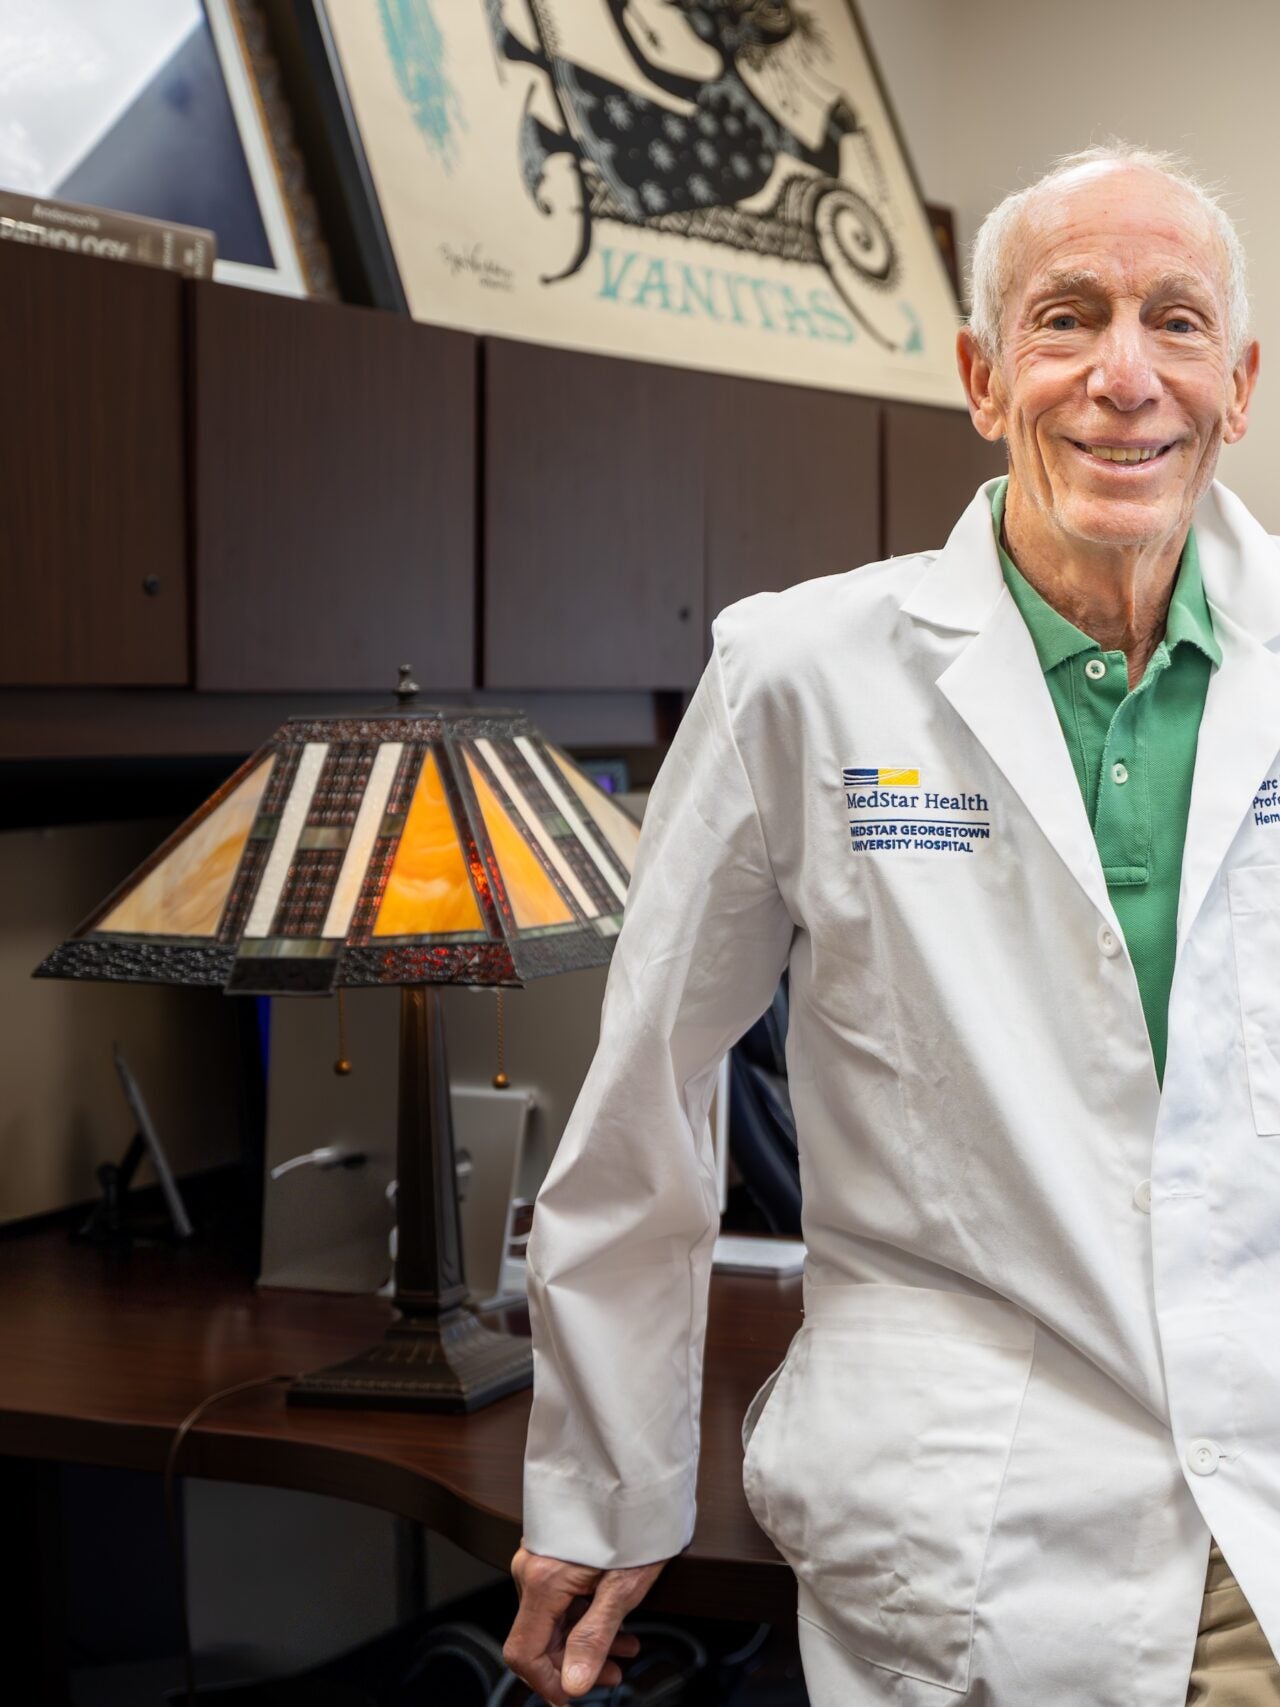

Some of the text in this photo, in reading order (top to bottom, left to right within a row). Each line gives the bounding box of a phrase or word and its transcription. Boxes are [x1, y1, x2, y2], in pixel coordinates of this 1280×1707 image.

[598, 247, 854, 345] VANITAS
[1258, 779, 1278, 791] arc
[846, 791, 989, 811] MedStar Health
[850, 824, 990, 839] MEDSTAR GEORGETOWN
[914, 839, 974, 853] HOSPITAL
